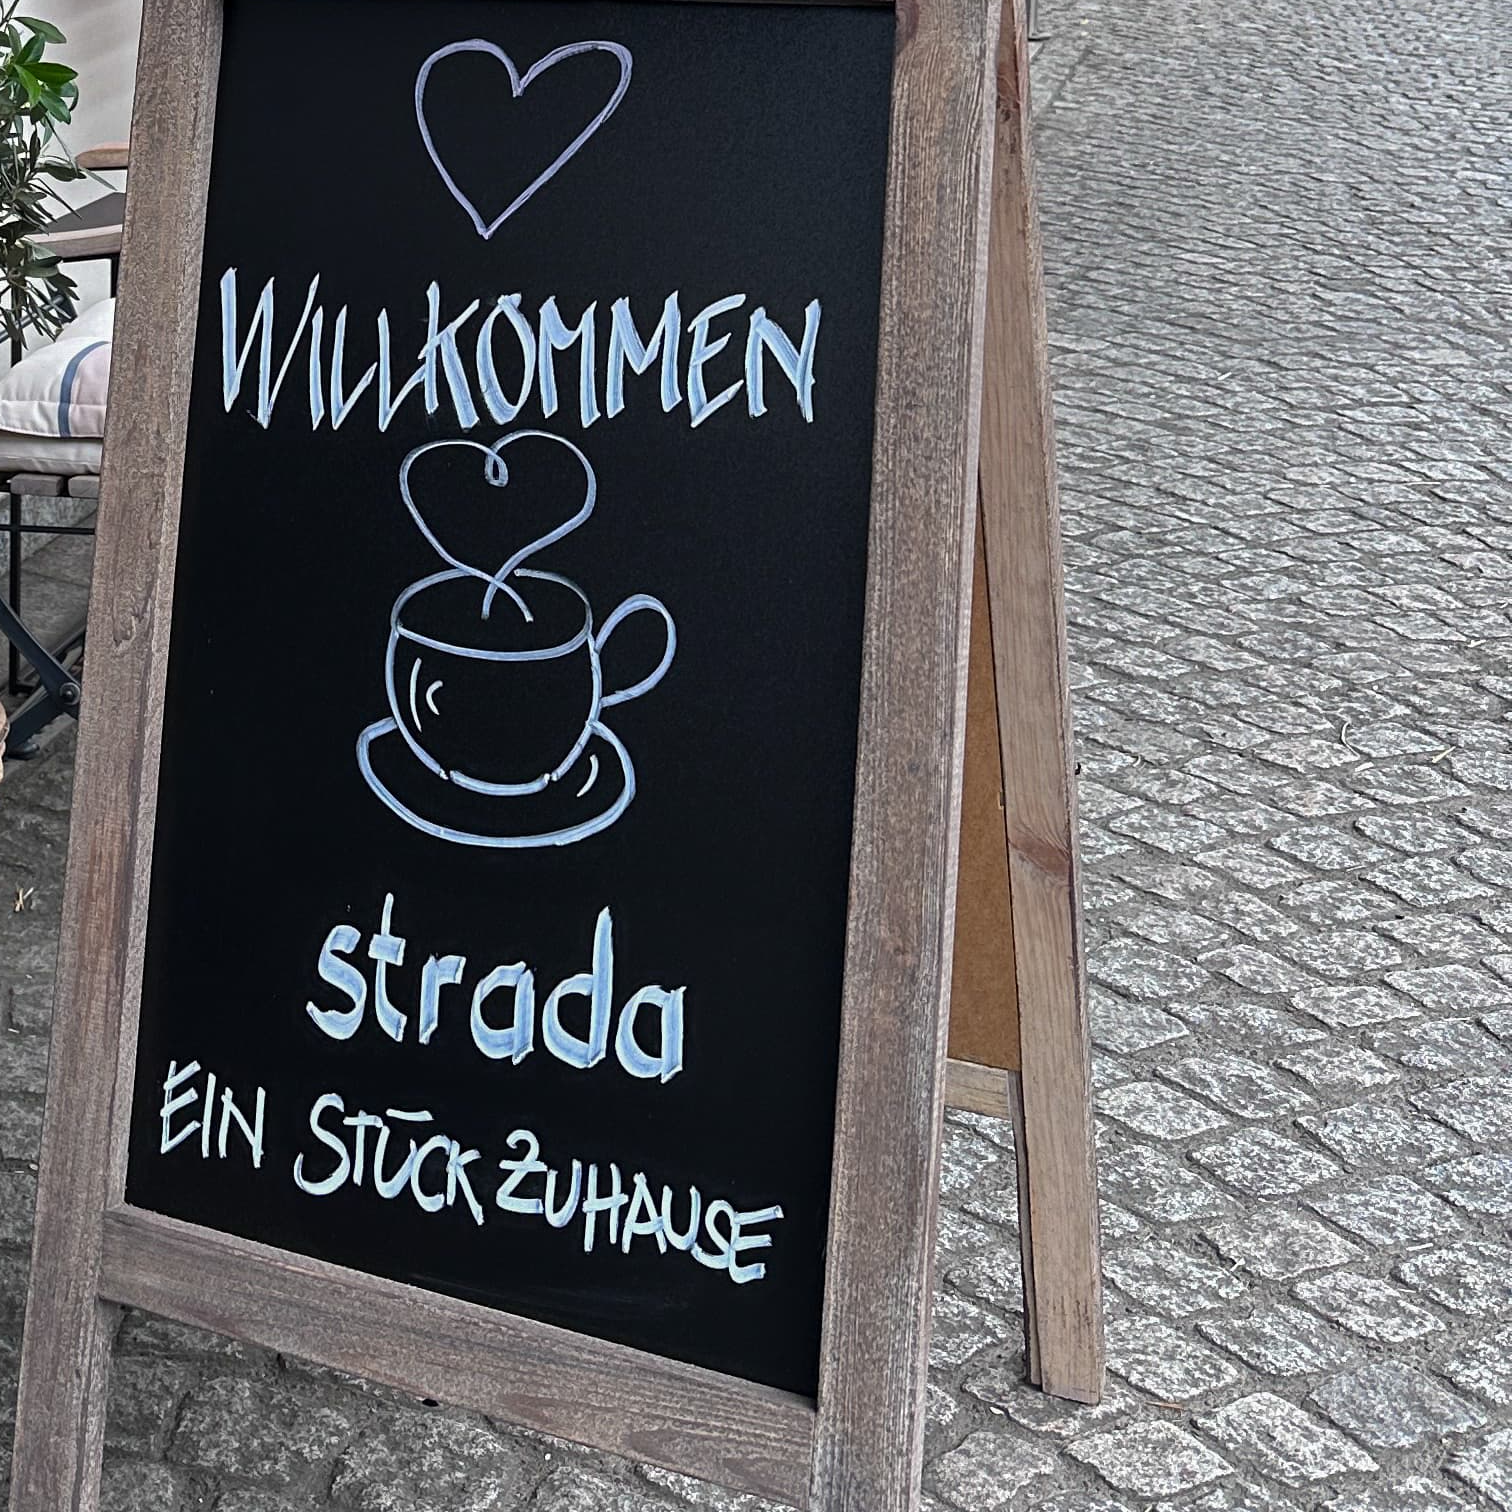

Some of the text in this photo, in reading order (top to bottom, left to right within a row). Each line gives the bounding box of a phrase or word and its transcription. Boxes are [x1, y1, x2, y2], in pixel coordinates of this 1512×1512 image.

[219, 265, 823, 432] WILLKOMMEN
[305, 891, 688, 1085] strada
[159, 1059, 266, 1169] EIN
[495, 1129, 785, 1284] ZUHAUSE
